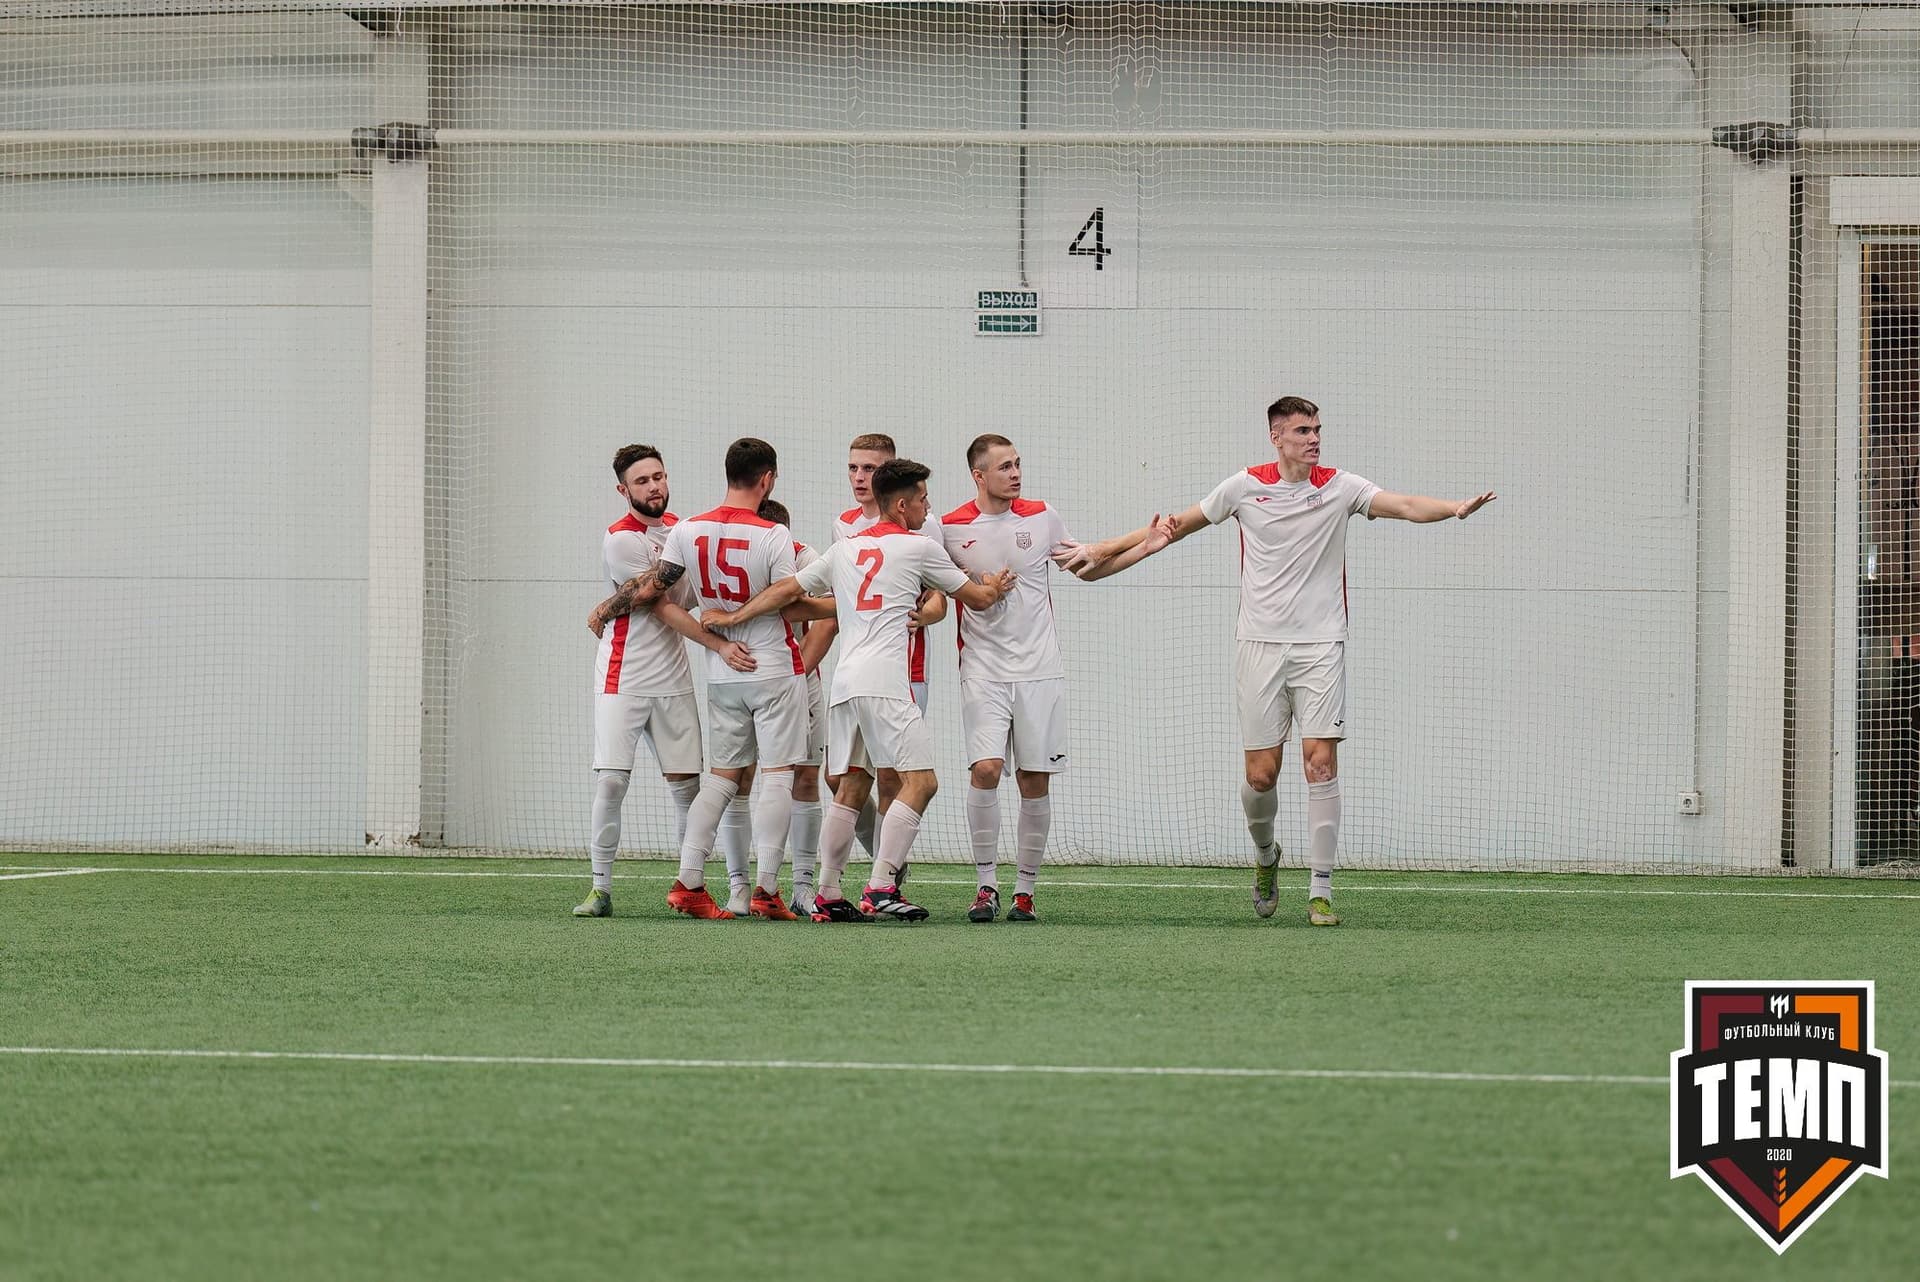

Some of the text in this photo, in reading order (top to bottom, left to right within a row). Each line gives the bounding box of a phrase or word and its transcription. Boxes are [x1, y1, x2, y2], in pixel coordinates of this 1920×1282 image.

[1068, 207, 1111, 270] 4
[981, 293, 1036, 308] ВЫХОД
[694, 535, 751, 603] 15
[855, 547, 885, 611] 2
